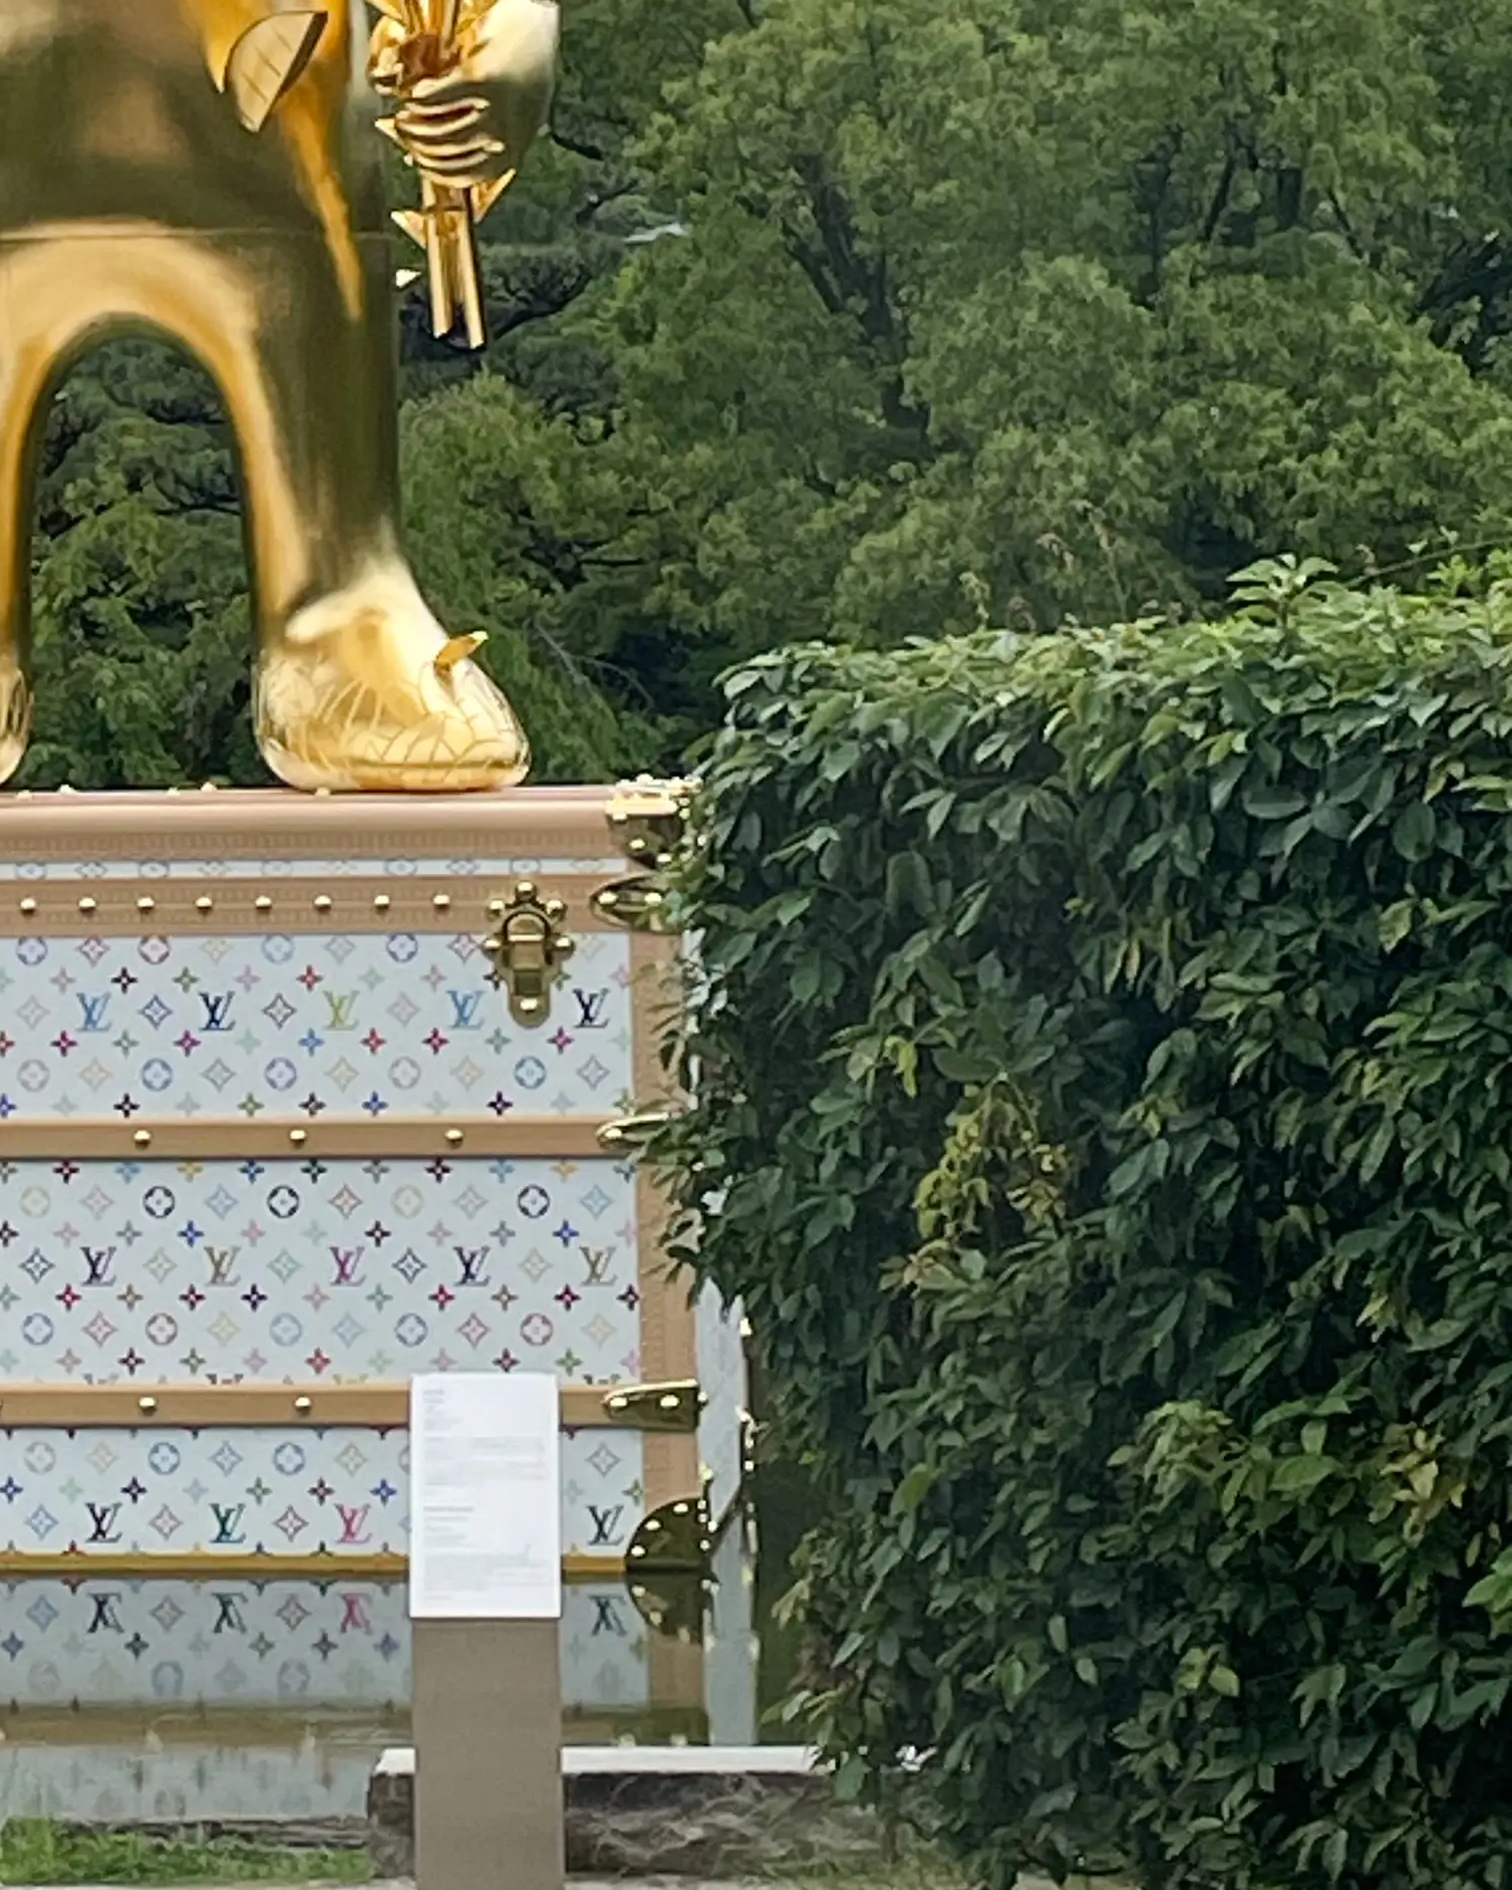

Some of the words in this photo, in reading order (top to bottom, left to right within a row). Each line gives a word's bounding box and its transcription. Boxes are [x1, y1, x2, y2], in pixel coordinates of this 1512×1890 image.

[76, 993, 111, 1032] LV
[199, 992, 235, 1031] LV
[322, 990, 360, 1031] LV
[446, 990, 484, 1030] LV
[573, 989, 608, 1028] LV
[80, 1247, 116, 1286] LV
[204, 1246, 241, 1286] LV
[329, 1246, 365, 1286] LV
[453, 1246, 490, 1286] LV
[579, 1246, 617, 1286] LV
[86, 1503, 122, 1543] LV
[210, 1503, 246, 1543] LV
[334, 1504, 372, 1544] LV
[587, 1506, 624, 1546] LV
